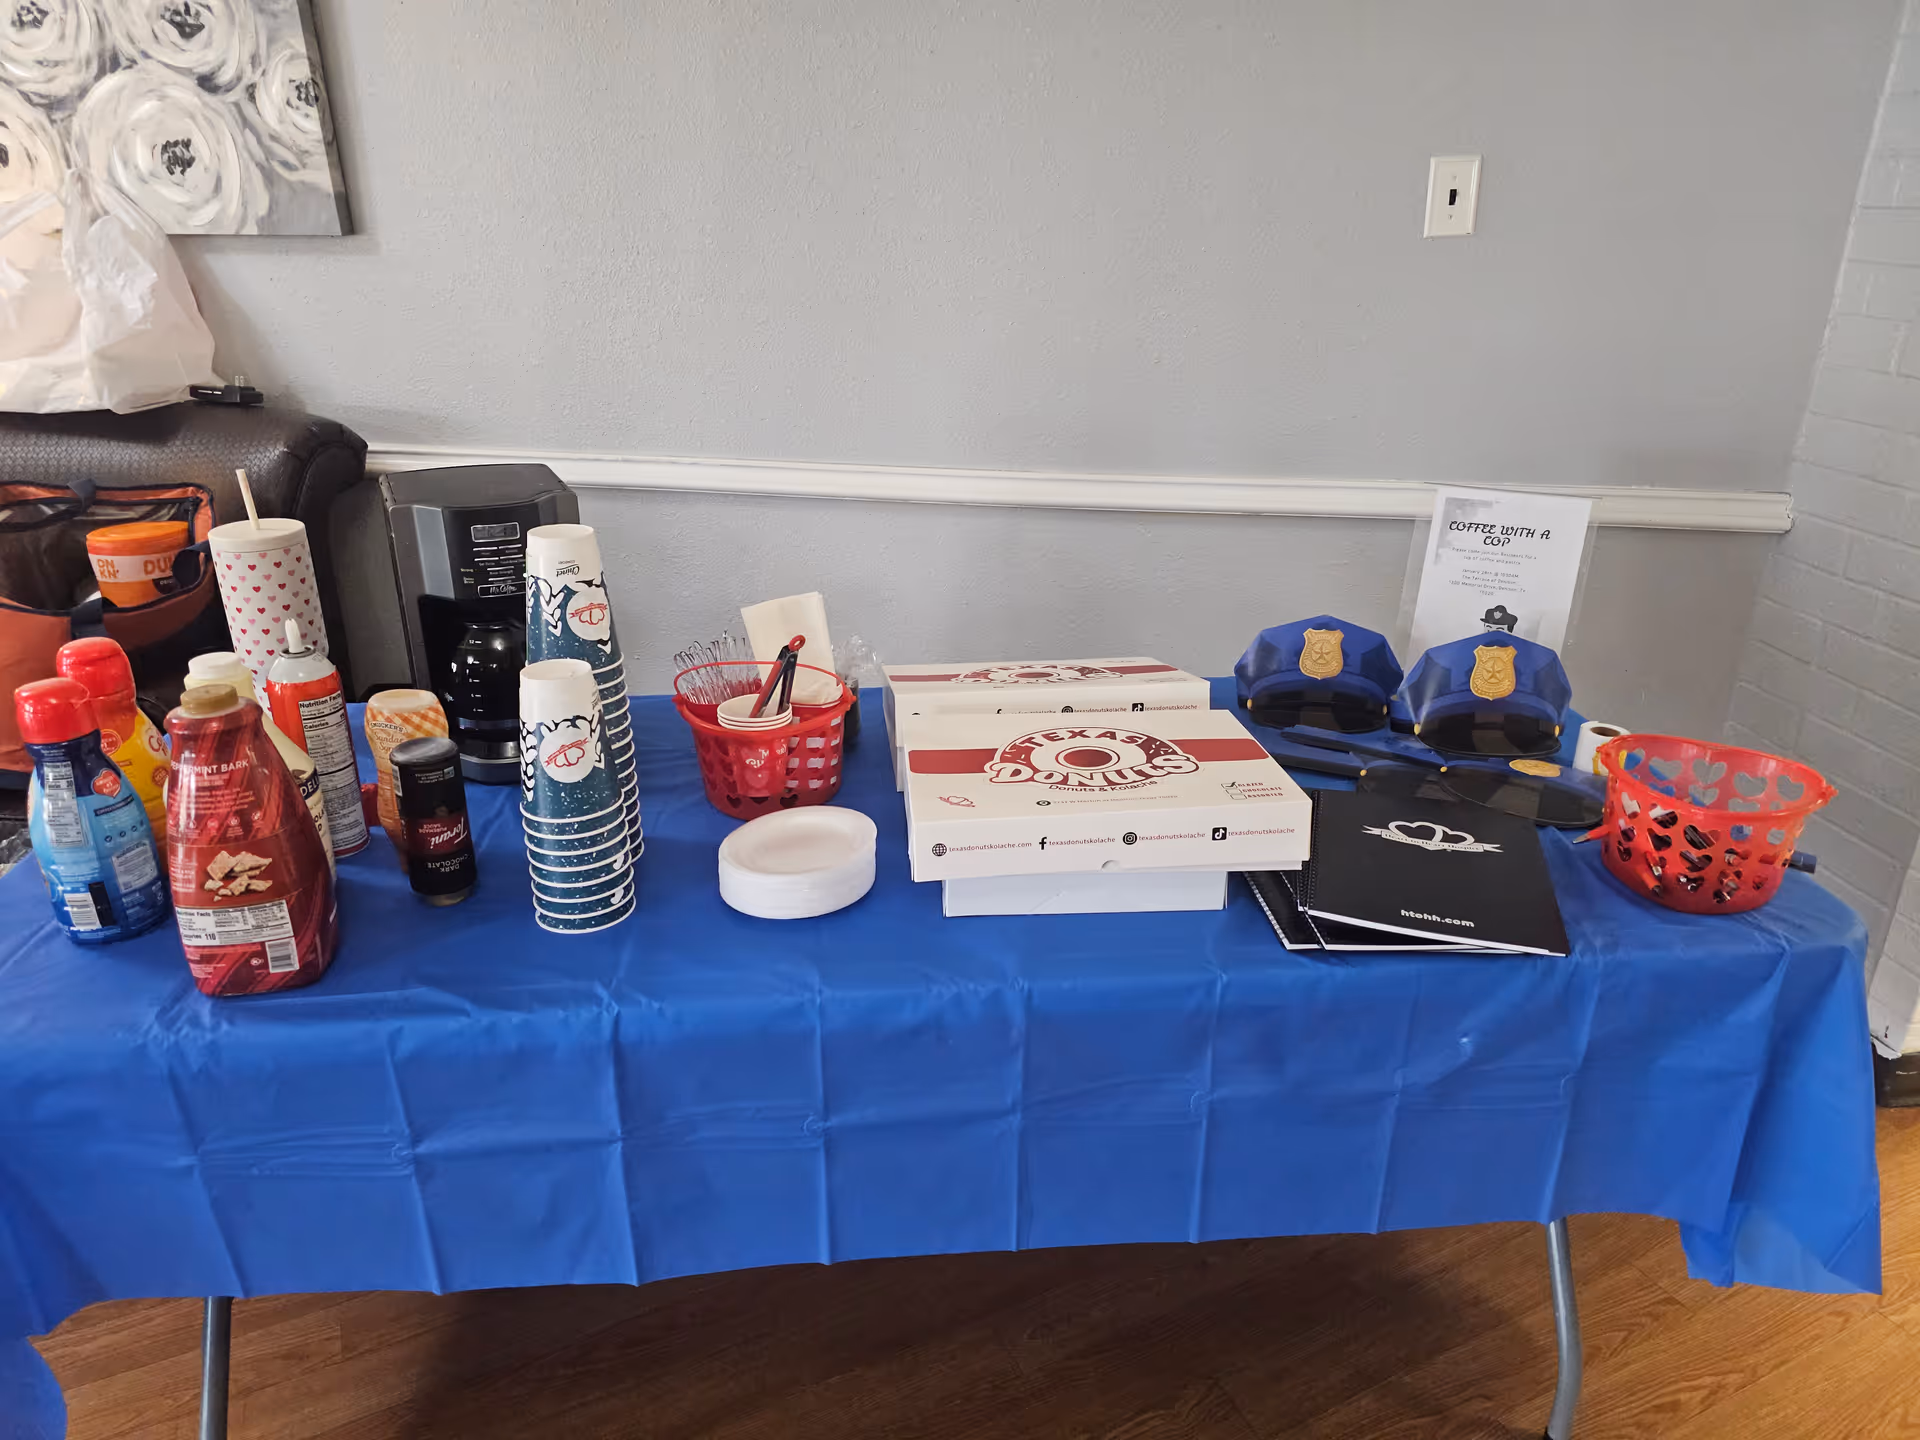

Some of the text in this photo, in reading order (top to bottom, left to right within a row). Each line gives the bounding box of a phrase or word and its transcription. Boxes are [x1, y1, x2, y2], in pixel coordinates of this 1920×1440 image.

[1448, 520, 1551, 540] COFFEE WITH A
[1483, 535, 1511, 547] COP
[555, 565, 580, 578] Chinet
[299, 699, 329, 710] Nutrition
[304, 721, 330, 730] Calories
[1019, 729, 1148, 748] TEXAS
[220, 759, 250, 773] BARK
[989, 754, 1199, 787] DONUTS
[1048, 783, 1095, 792] Donuts
[430, 816, 468, 849] Torani
[1139, 832, 1206, 841] texasdonutskolache
[1228, 828, 1296, 837] texasdonutskolache
[949, 842, 1033, 852] texasdonutskolache.com
[1049, 837, 1116, 846] texasdonutskolache
[440, 863, 461, 873] DARK
[1400, 909, 1475, 928] htohh.com
[204, 932, 217, 942] 110
